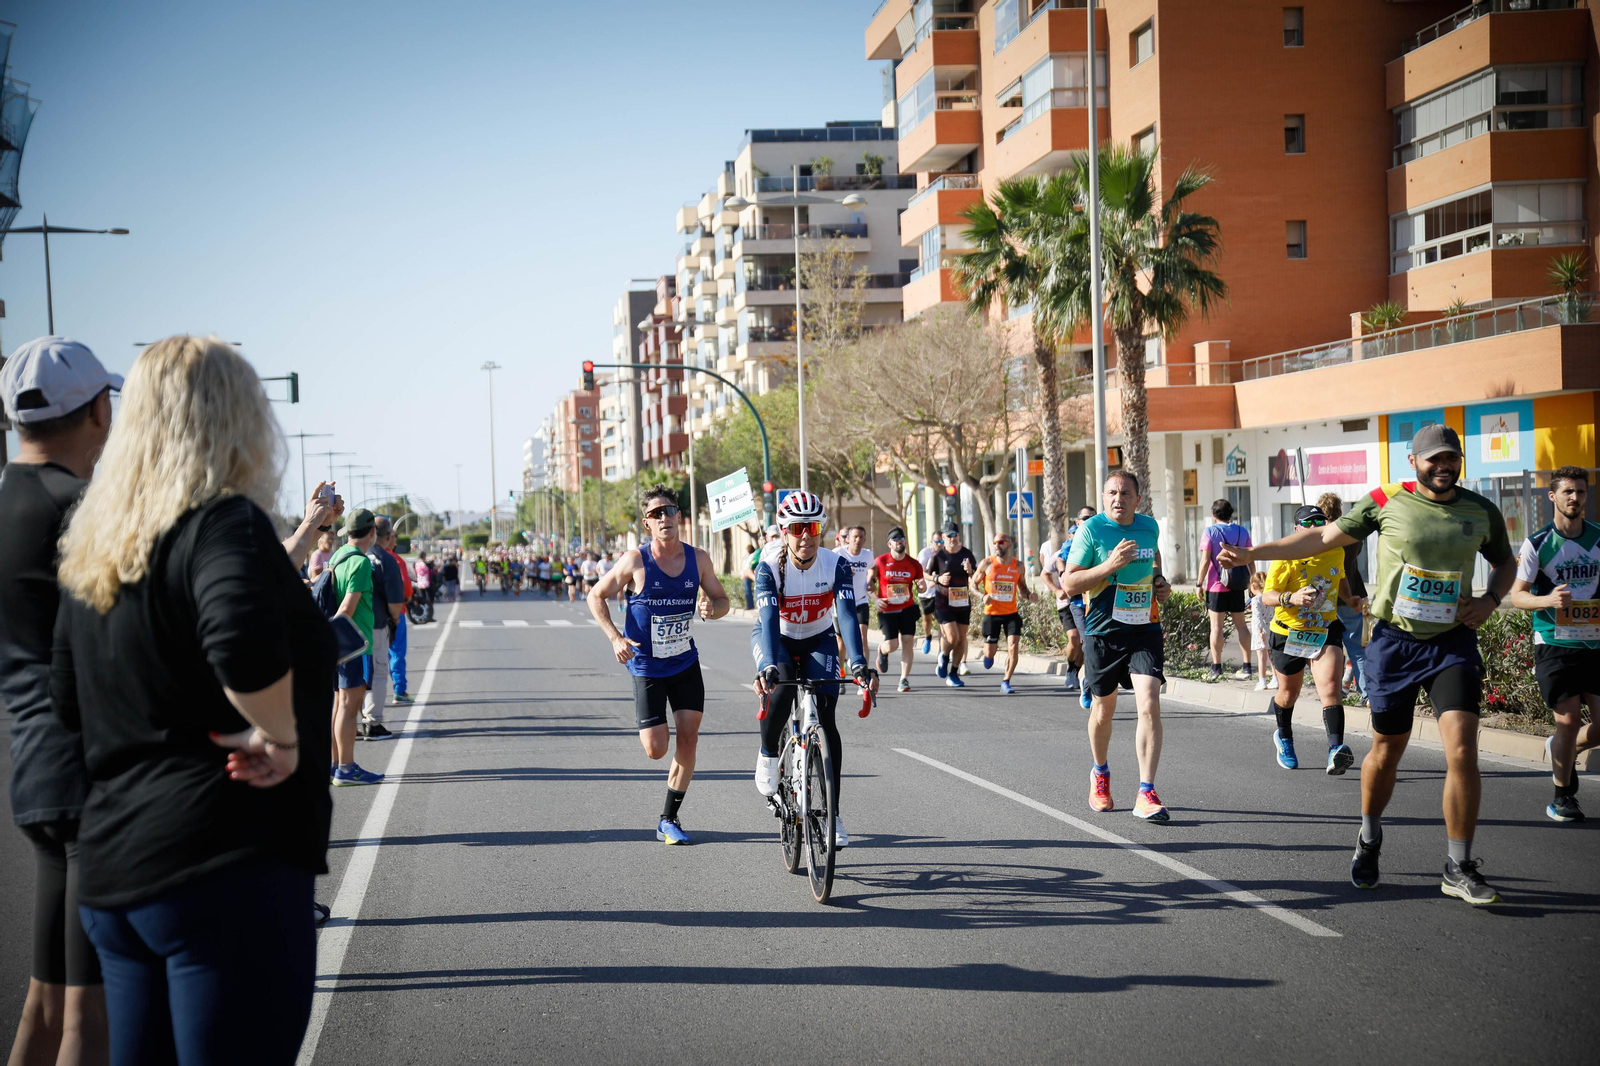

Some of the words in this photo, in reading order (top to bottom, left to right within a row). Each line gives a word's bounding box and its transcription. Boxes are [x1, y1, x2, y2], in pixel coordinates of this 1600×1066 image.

[1406, 576, 1454, 596] 2094
[786, 599, 820, 608] BICICLETAS
[1124, 592, 1147, 604] 365
[1562, 607, 1599, 618] 1082
[657, 620, 690, 637] 5784
[1296, 632, 1320, 642] 677
